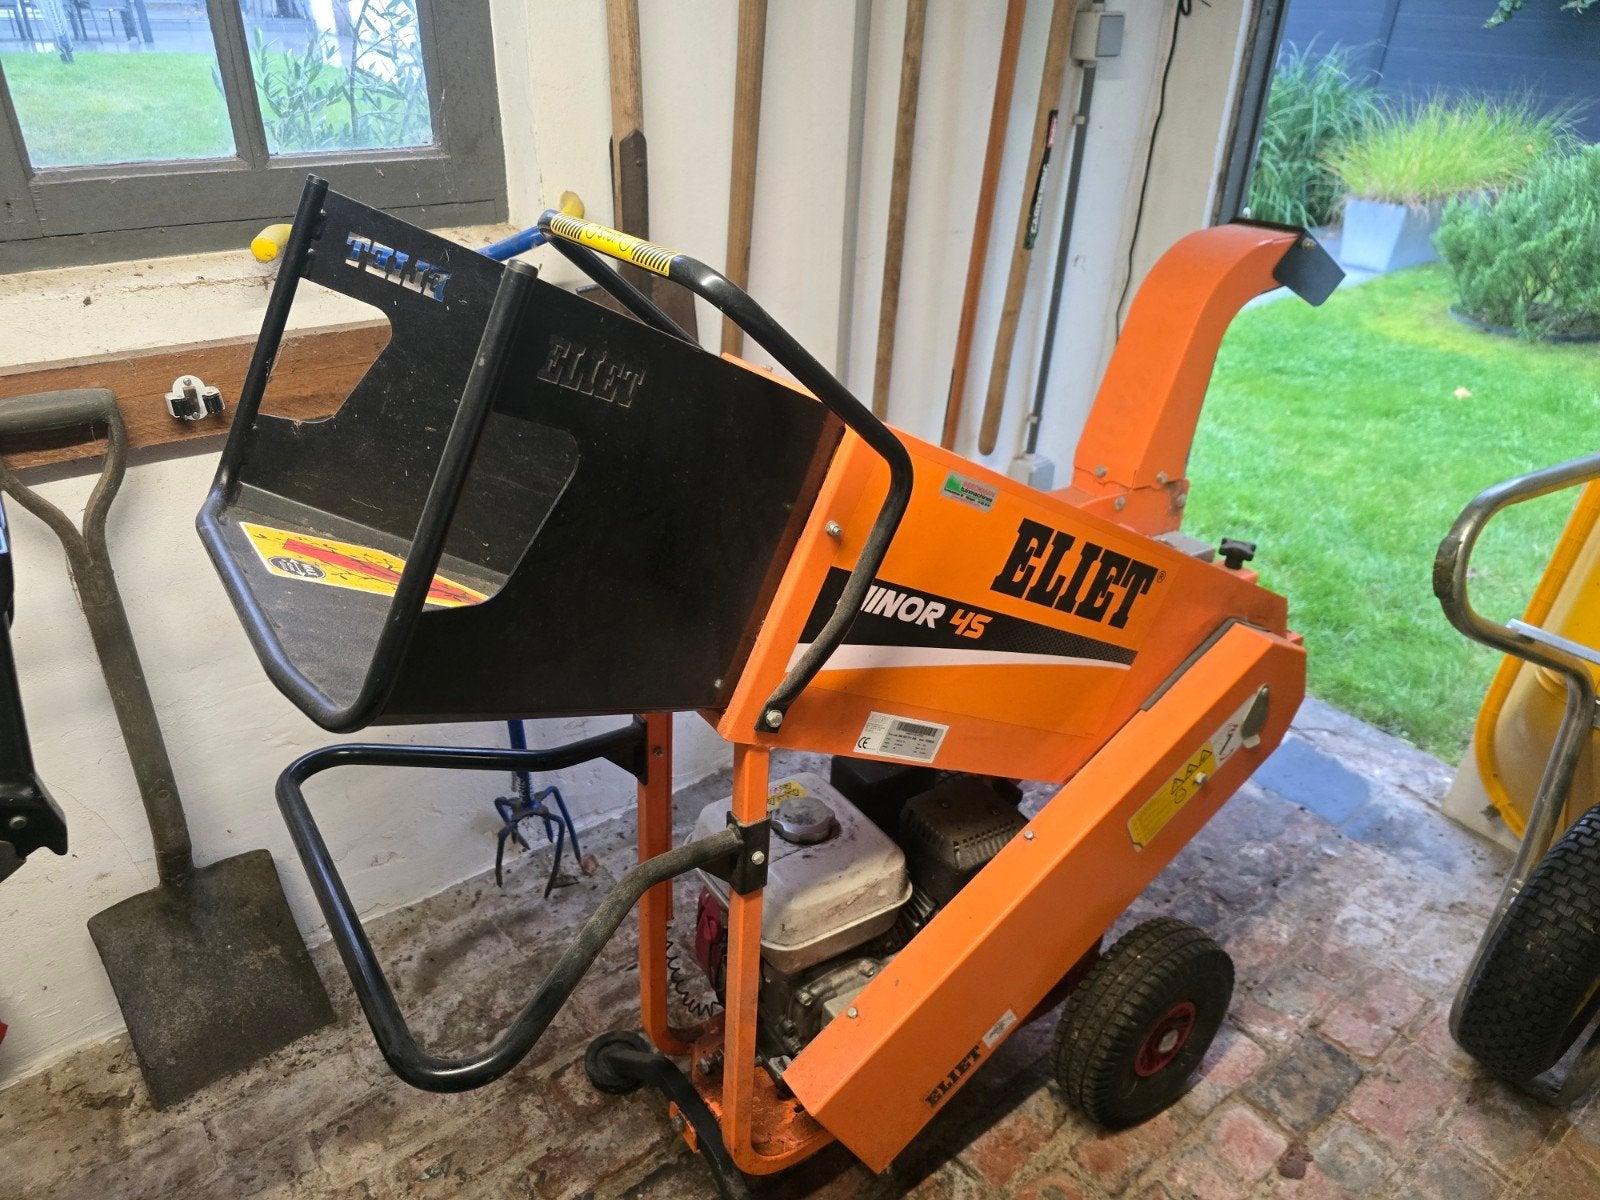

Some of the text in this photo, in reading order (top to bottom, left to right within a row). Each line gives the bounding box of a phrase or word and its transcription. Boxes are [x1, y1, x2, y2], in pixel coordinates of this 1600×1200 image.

[537, 337, 648, 408] ELIET
[990, 517, 1159, 630] ELIET
[949, 608, 994, 640] 45
[925, 1044, 981, 1109] ELIET
